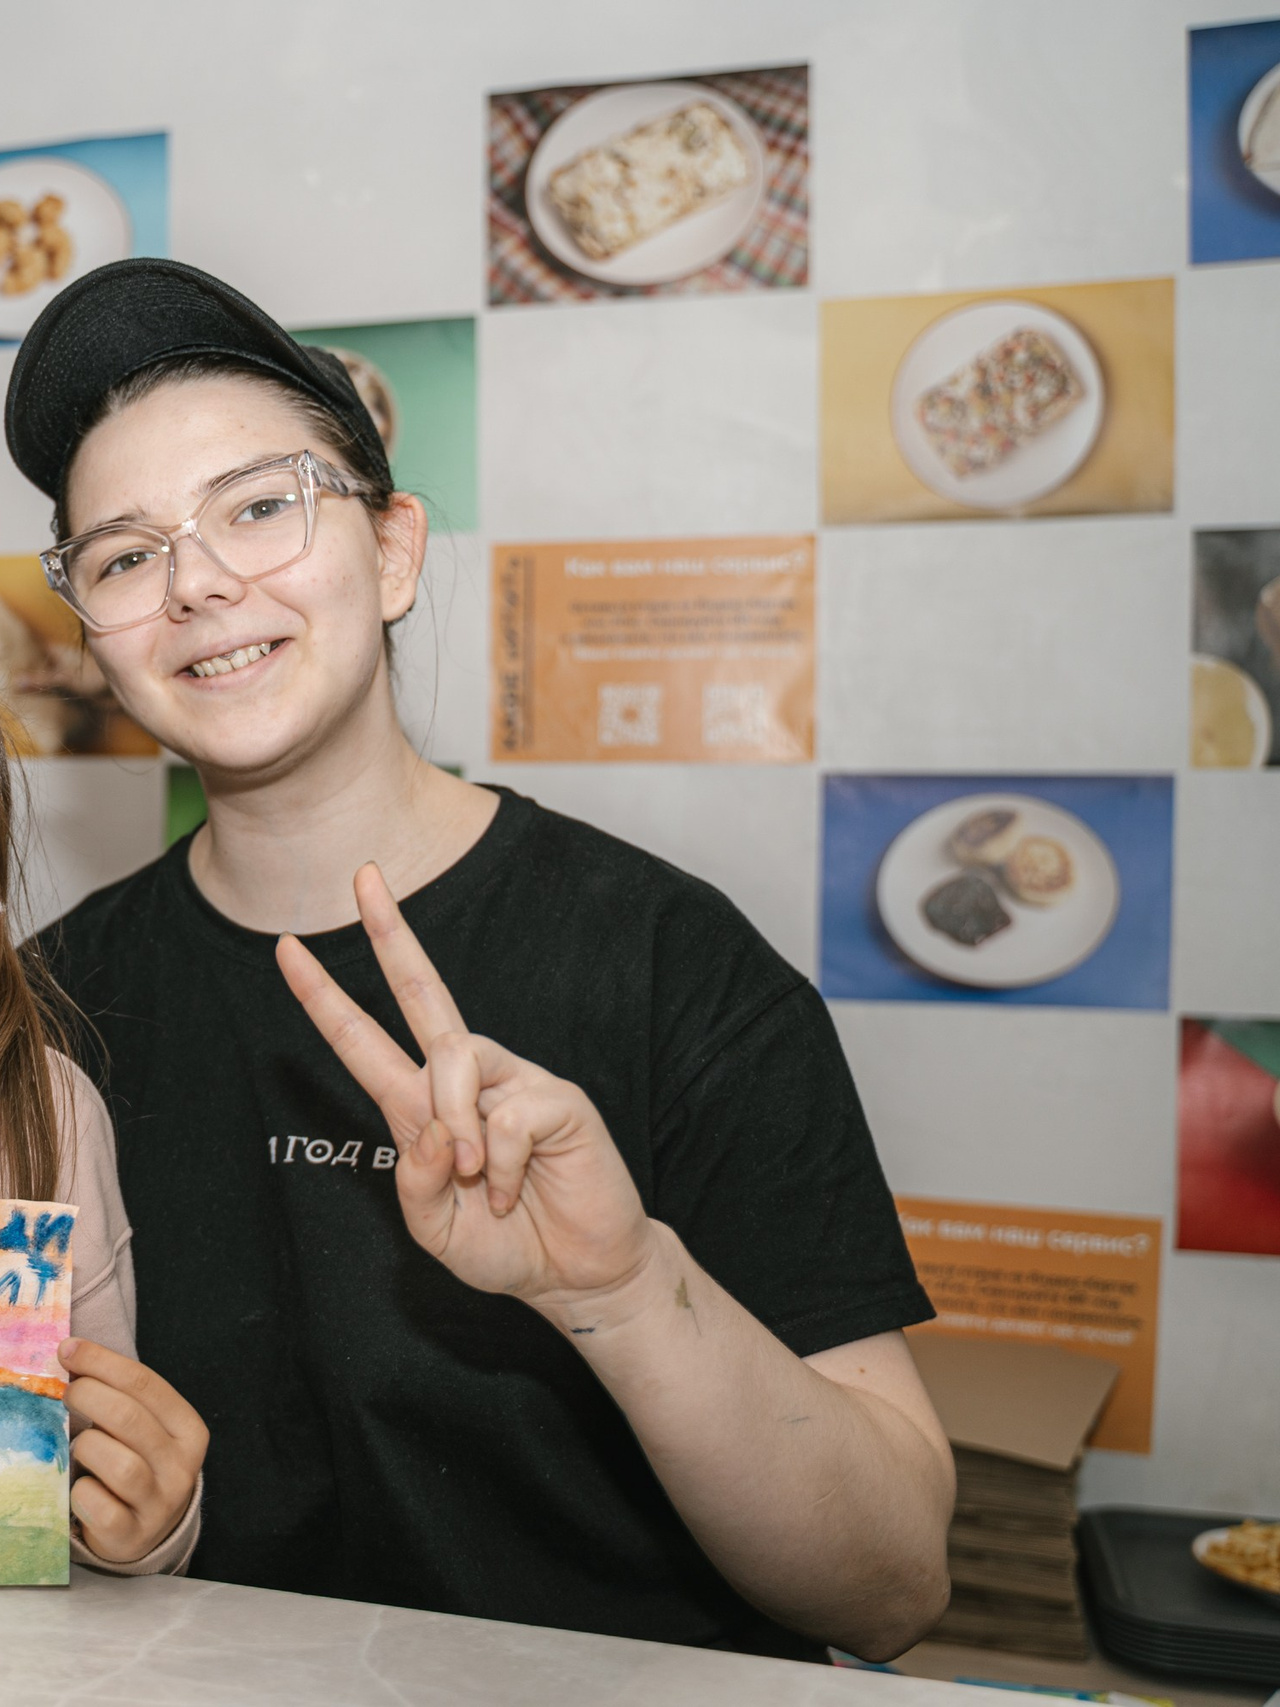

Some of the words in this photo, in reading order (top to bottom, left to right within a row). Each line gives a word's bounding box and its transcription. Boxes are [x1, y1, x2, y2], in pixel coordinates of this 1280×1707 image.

[937, 1219, 985, 1242] вам
[990, 1225, 1043, 1249] наш
[1046, 1230, 1151, 1257] сервис?
